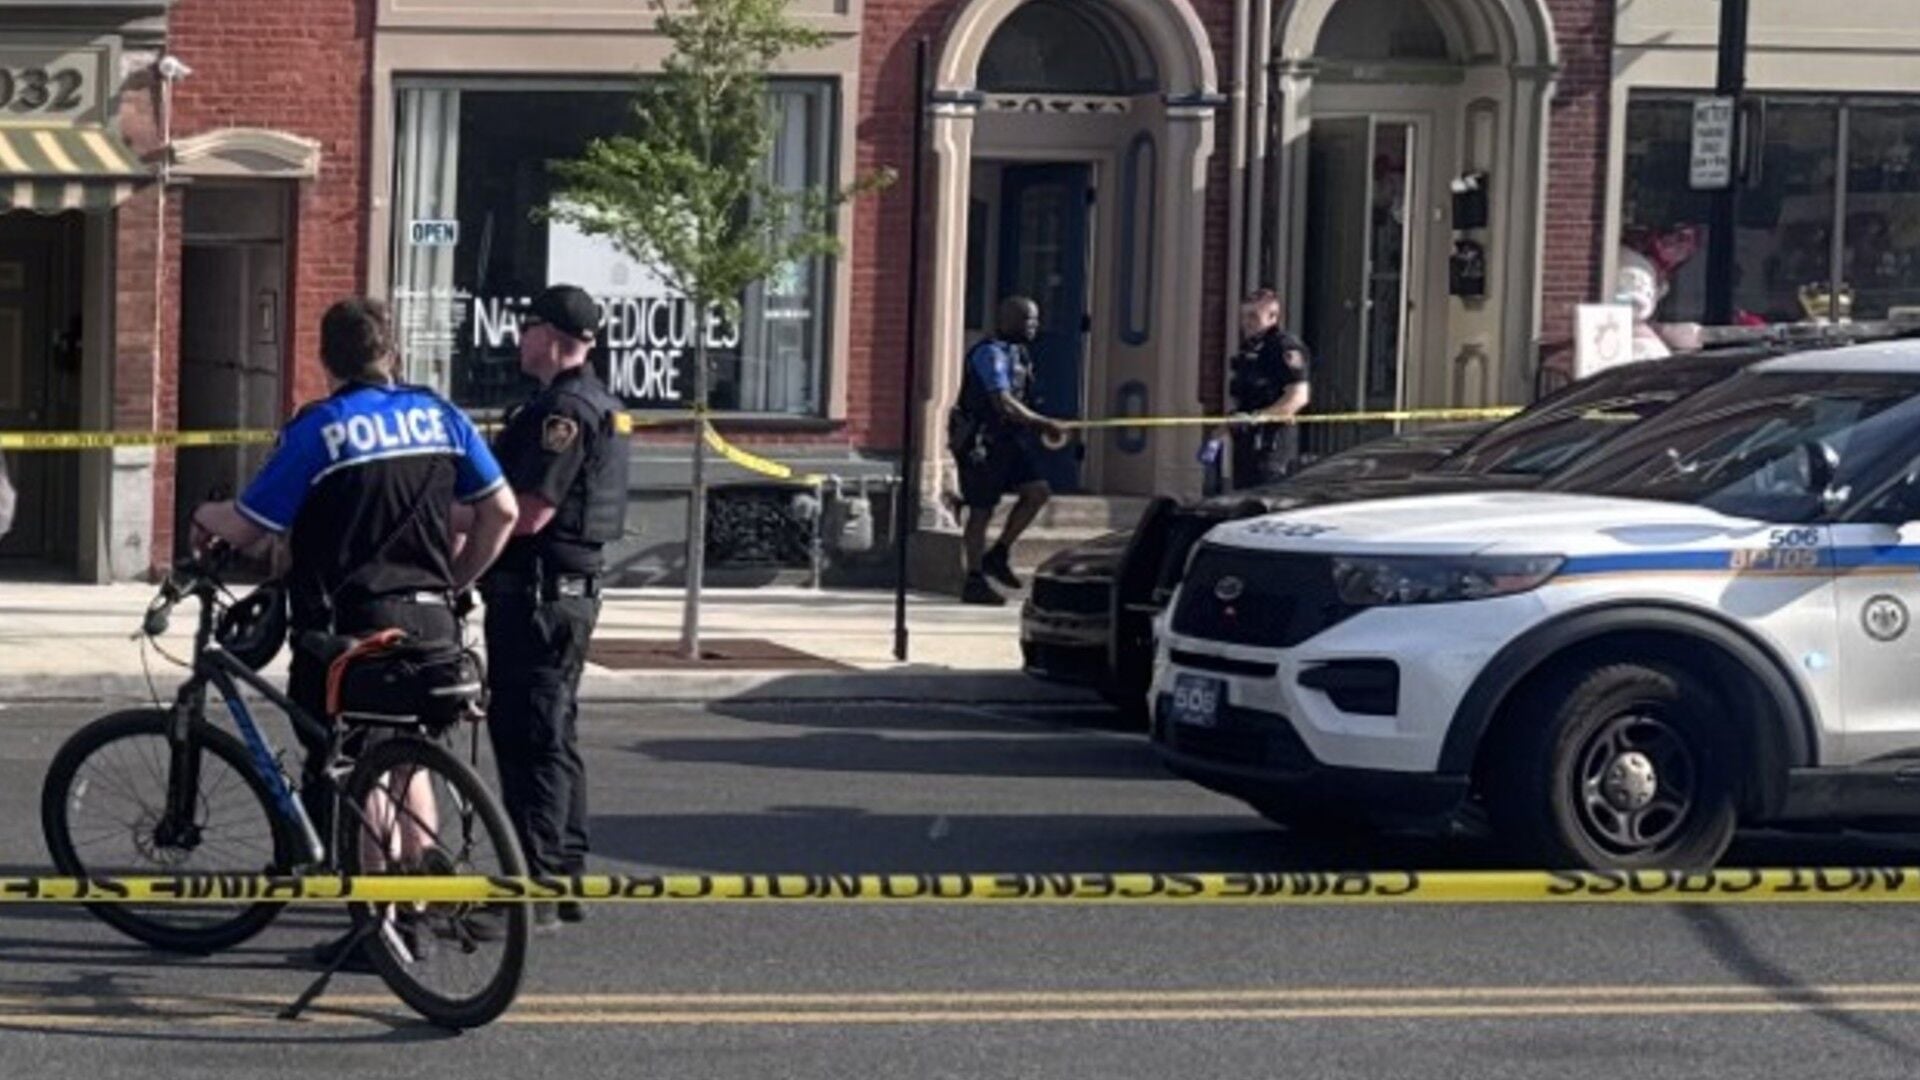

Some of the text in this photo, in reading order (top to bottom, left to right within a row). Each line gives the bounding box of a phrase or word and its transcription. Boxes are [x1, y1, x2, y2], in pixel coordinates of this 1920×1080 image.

[412, 223, 455, 242] OPEN
[608, 348, 691, 399] MORE
[321, 407, 449, 461] POLICE
[1769, 528, 1820, 547] 506
